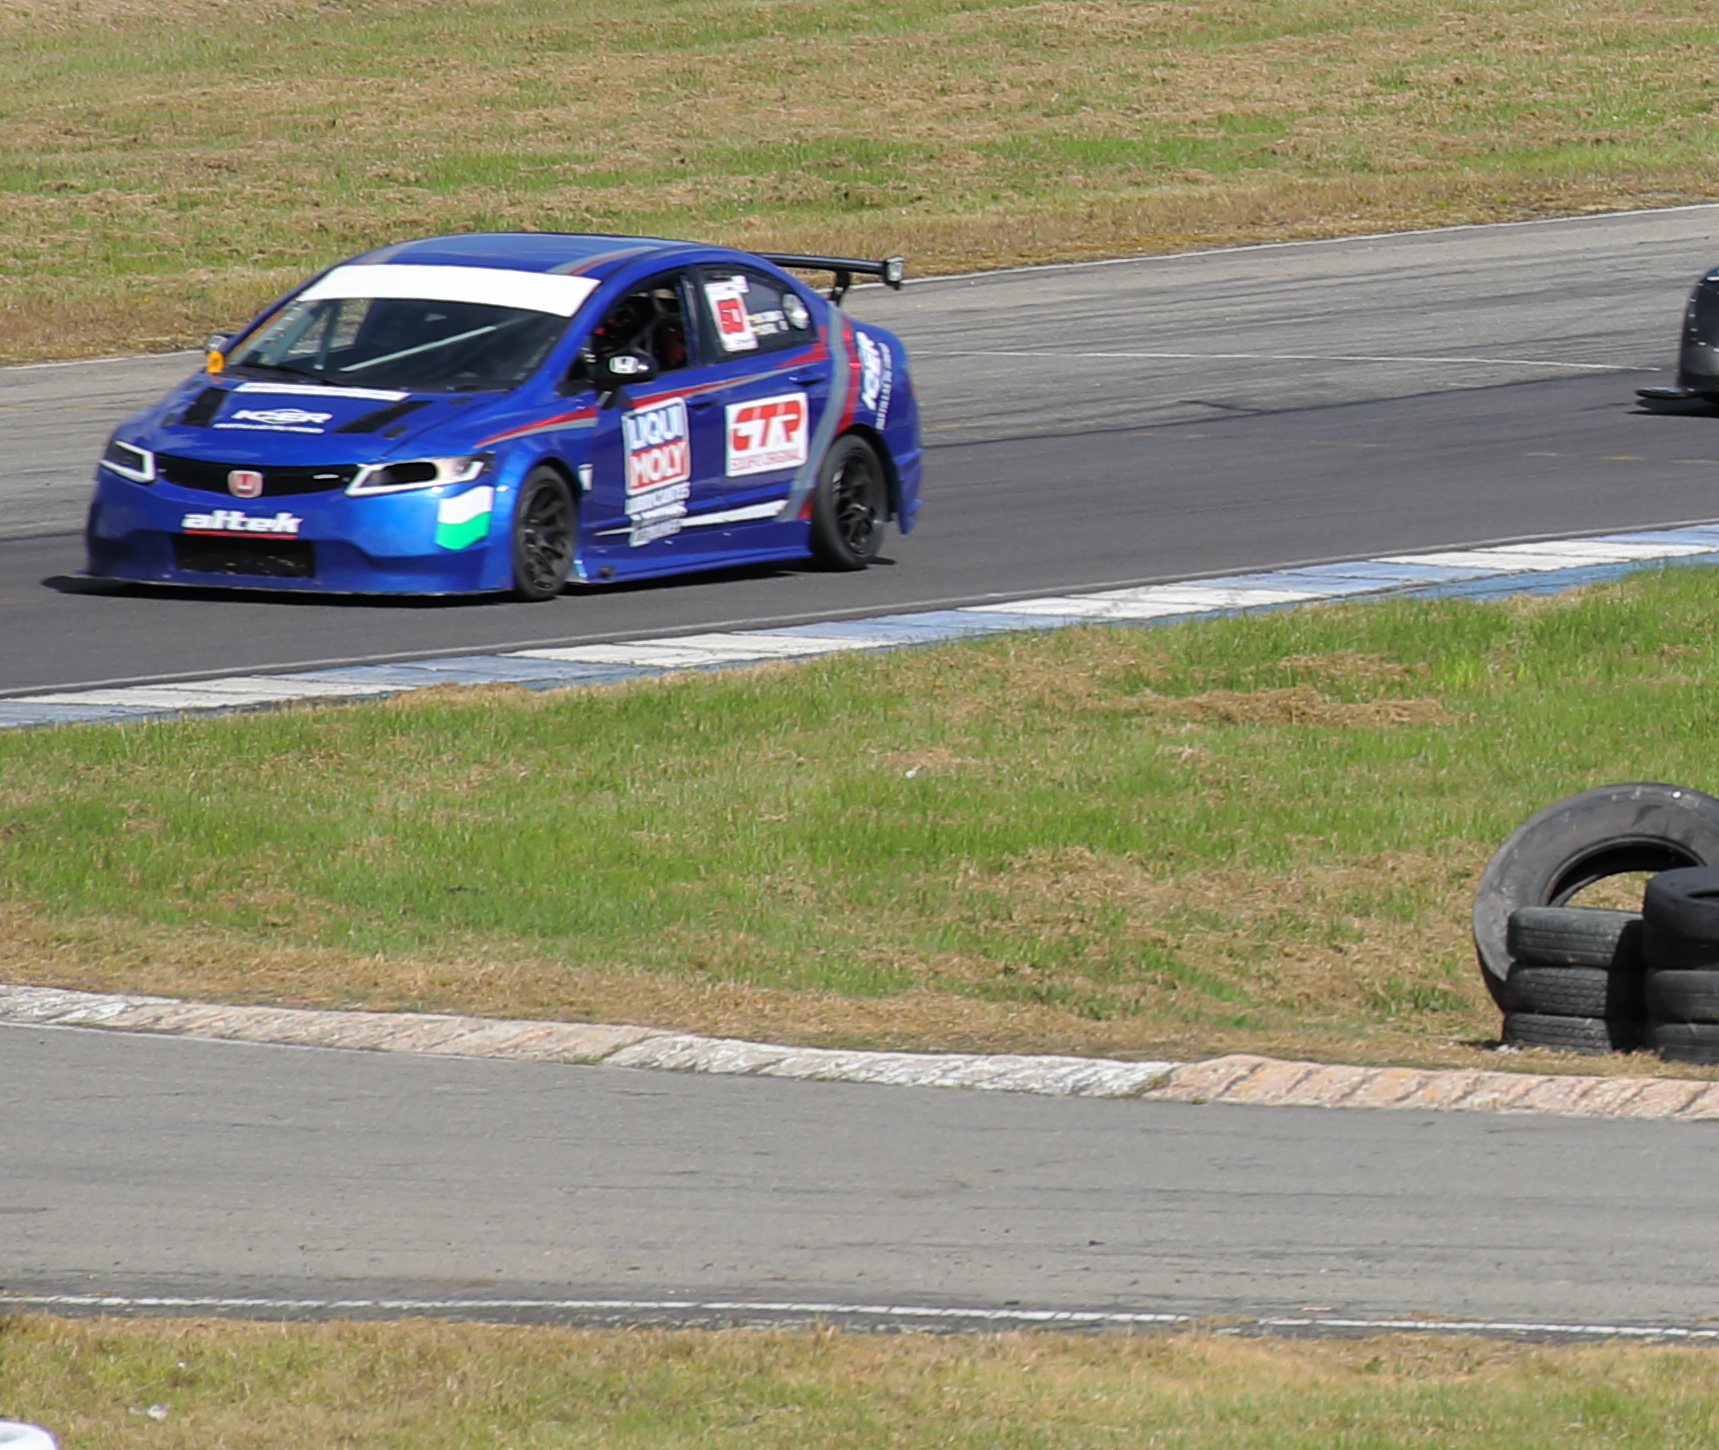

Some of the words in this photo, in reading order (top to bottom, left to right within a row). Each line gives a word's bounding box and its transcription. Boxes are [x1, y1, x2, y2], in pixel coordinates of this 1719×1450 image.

[627, 405, 684, 450] LIQUI
[629, 441, 687, 488] MOLY
[181, 509, 303, 533] altek
